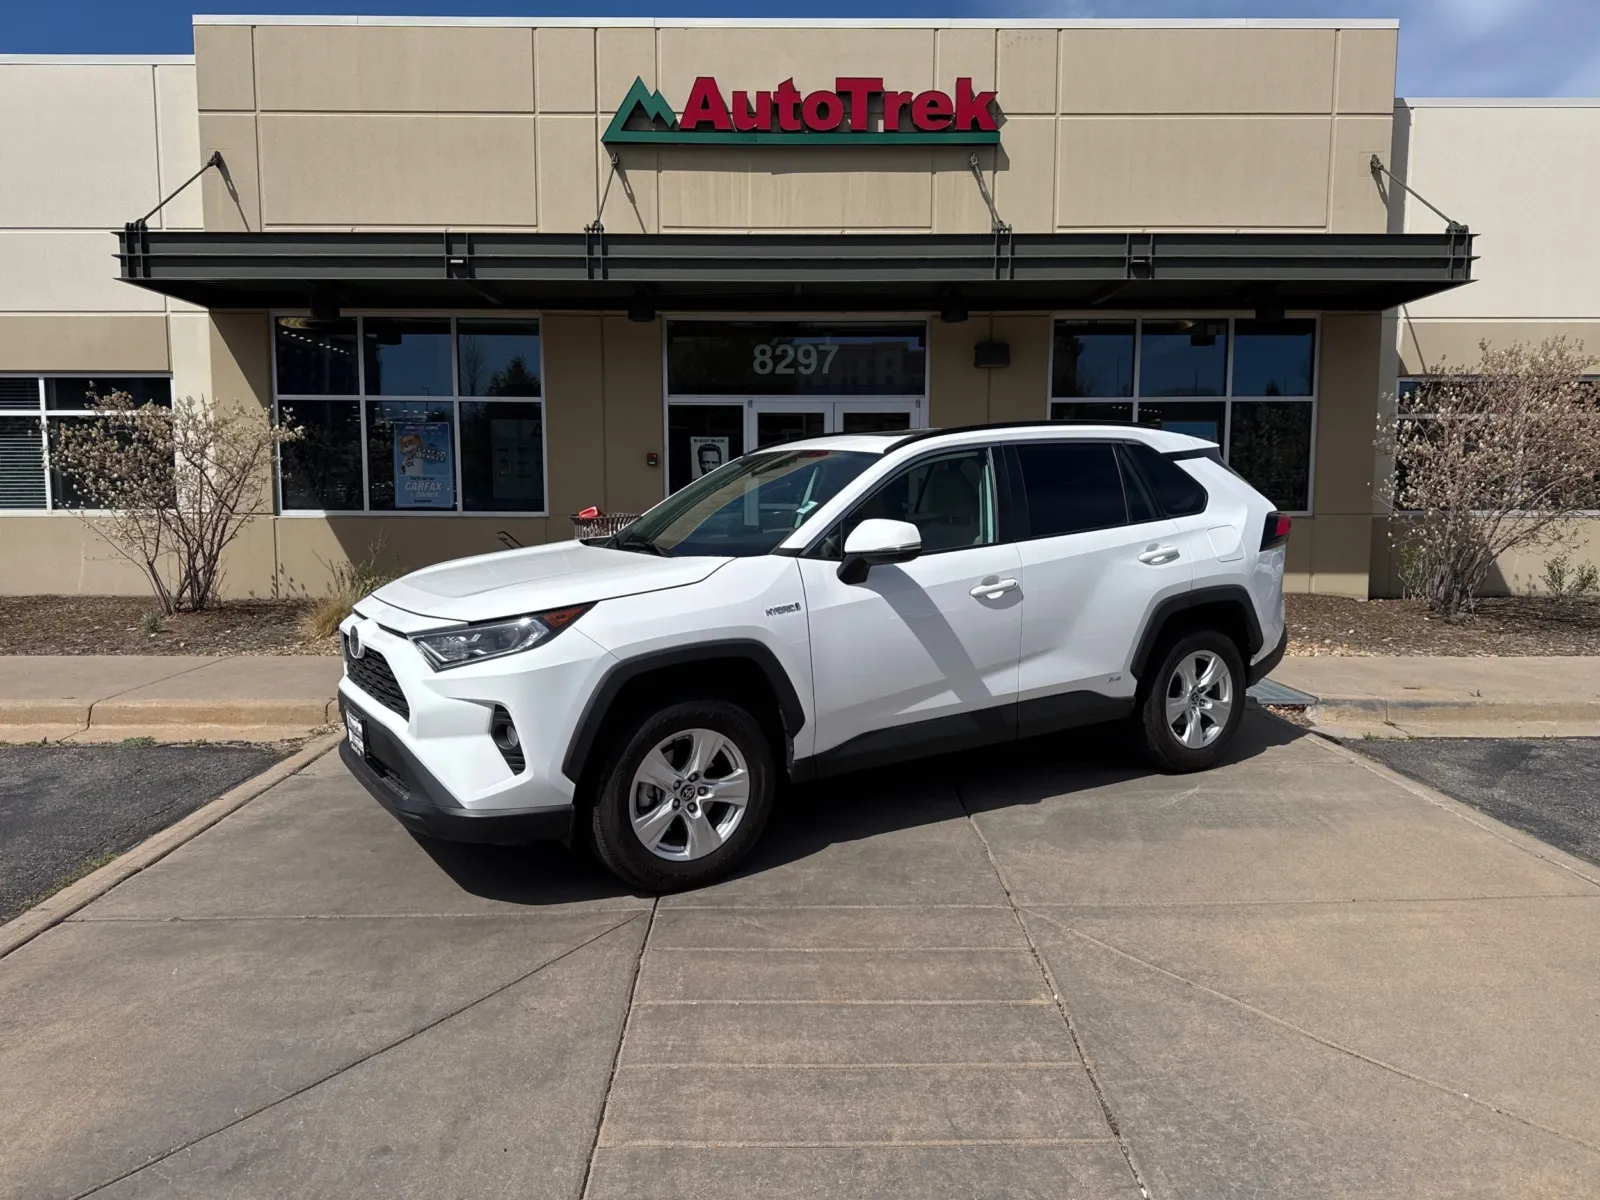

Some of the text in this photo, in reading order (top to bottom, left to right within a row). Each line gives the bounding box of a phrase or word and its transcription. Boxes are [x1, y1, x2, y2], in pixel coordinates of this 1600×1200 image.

[679, 76, 999, 131] AutoTrek
[752, 343, 840, 375] 8297
[405, 481, 442, 491] CARFAX
